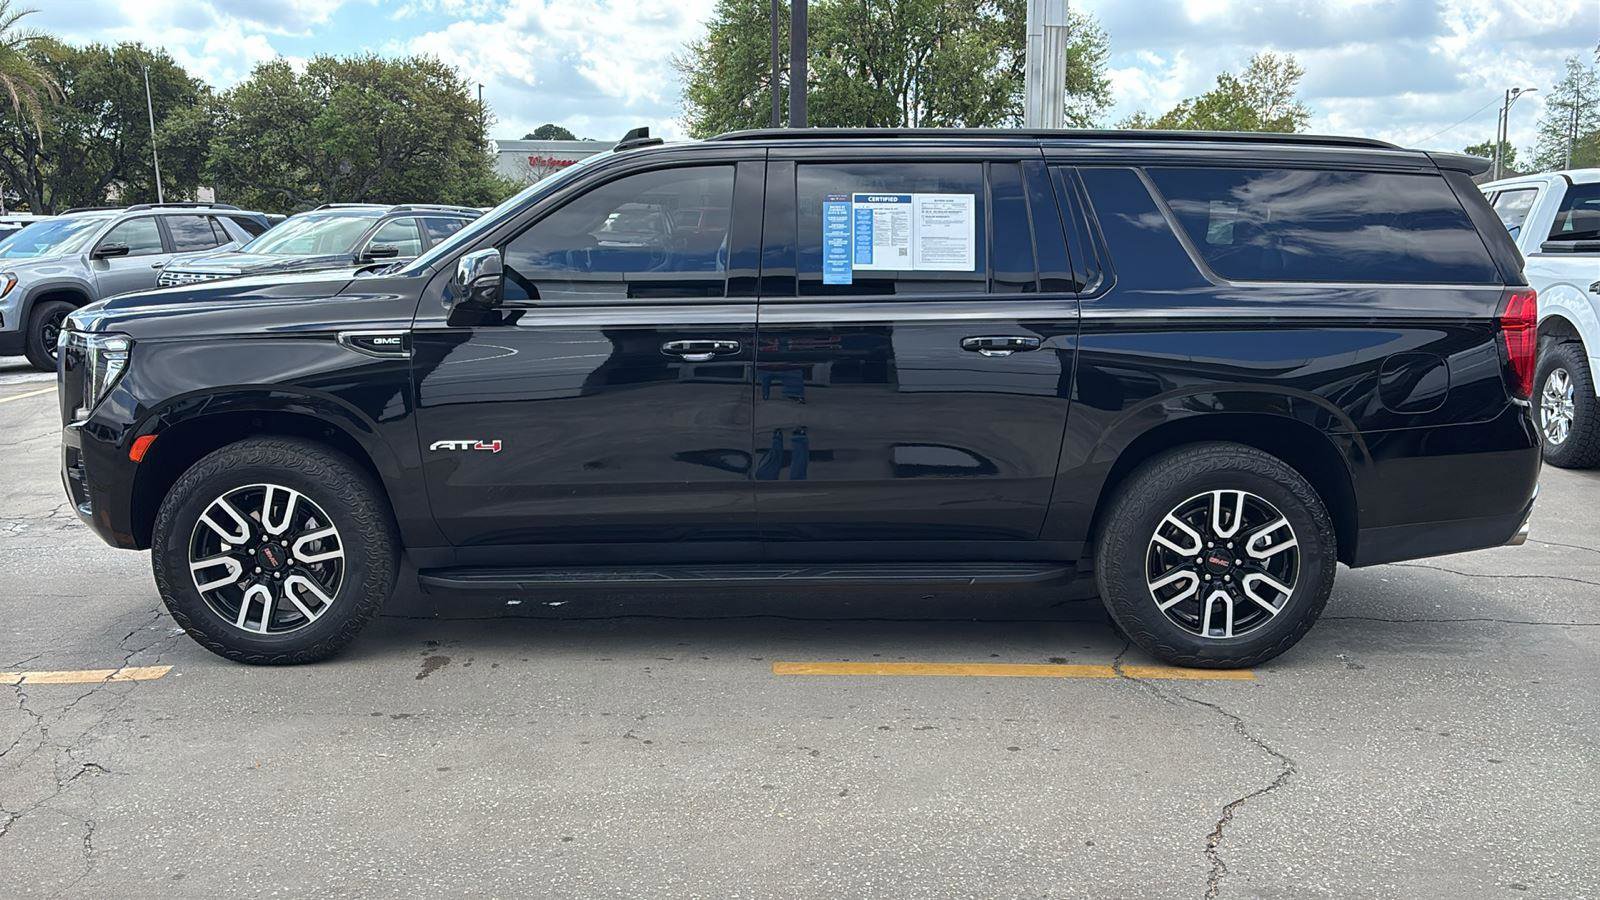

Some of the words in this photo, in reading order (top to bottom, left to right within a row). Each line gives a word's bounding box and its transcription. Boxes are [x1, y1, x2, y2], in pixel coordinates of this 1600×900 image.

[528, 156, 580, 168] Walgreen
[373, 337, 401, 345] GMC
[429, 439, 503, 453] AT4
[263, 547, 279, 567] GMC
[1208, 556, 1230, 567] GMC
